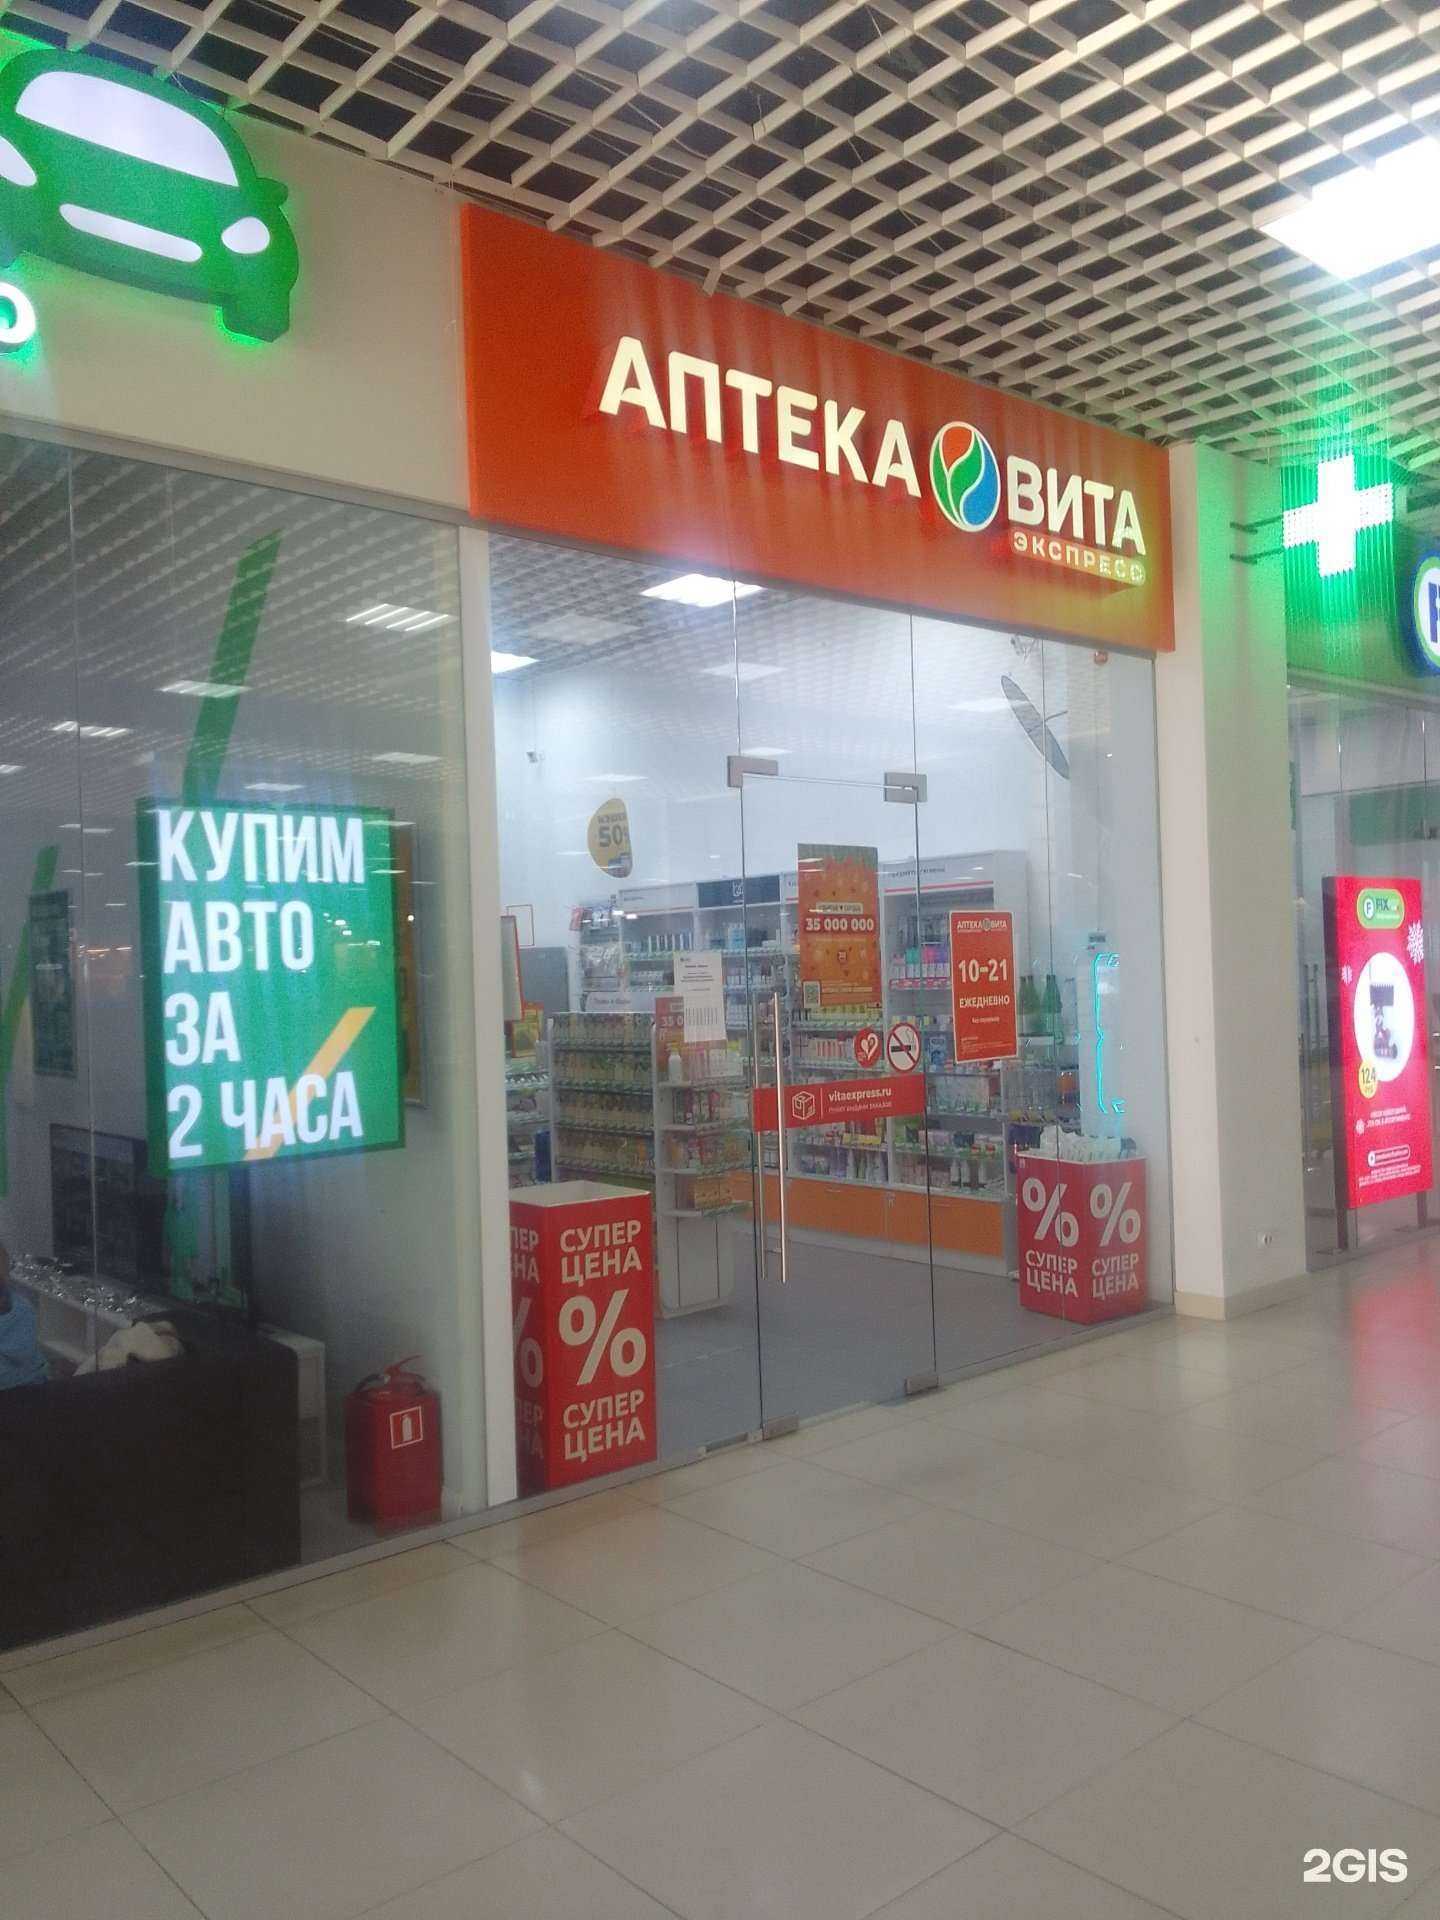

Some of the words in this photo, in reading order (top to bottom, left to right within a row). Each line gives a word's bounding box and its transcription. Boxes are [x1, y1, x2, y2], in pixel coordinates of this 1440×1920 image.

[598, 335, 921, 498] АПТЕКА
[1007, 455, 1147, 555] ВИТА
[1013, 531, 1145, 583] ЭКСПРЕСС
[157, 809, 366, 883] КУПИМ
[163, 900, 315, 974] АВТО
[959, 995, 1010, 1009] ЕЖЕДНЕВНО
[163, 991, 242, 1066] ЗА
[167, 1084, 204, 1159] 2
[220, 1071, 364, 1150] ЧАСА
[560, 1219, 642, 1254] СУПЕР
[560, 1246, 643, 1288] ЦЕНА
[1026, 1249, 1078, 1275] СУПЕР
[1092, 1252, 1140, 1277] СУПЕР
[1026, 1269, 1078, 1299] ЦЕНА
[1092, 1271, 1140, 1301] ЦЕНА
[563, 1389, 645, 1430] СУПЕР
[564, 1416, 646, 1463] ЦЕНА
